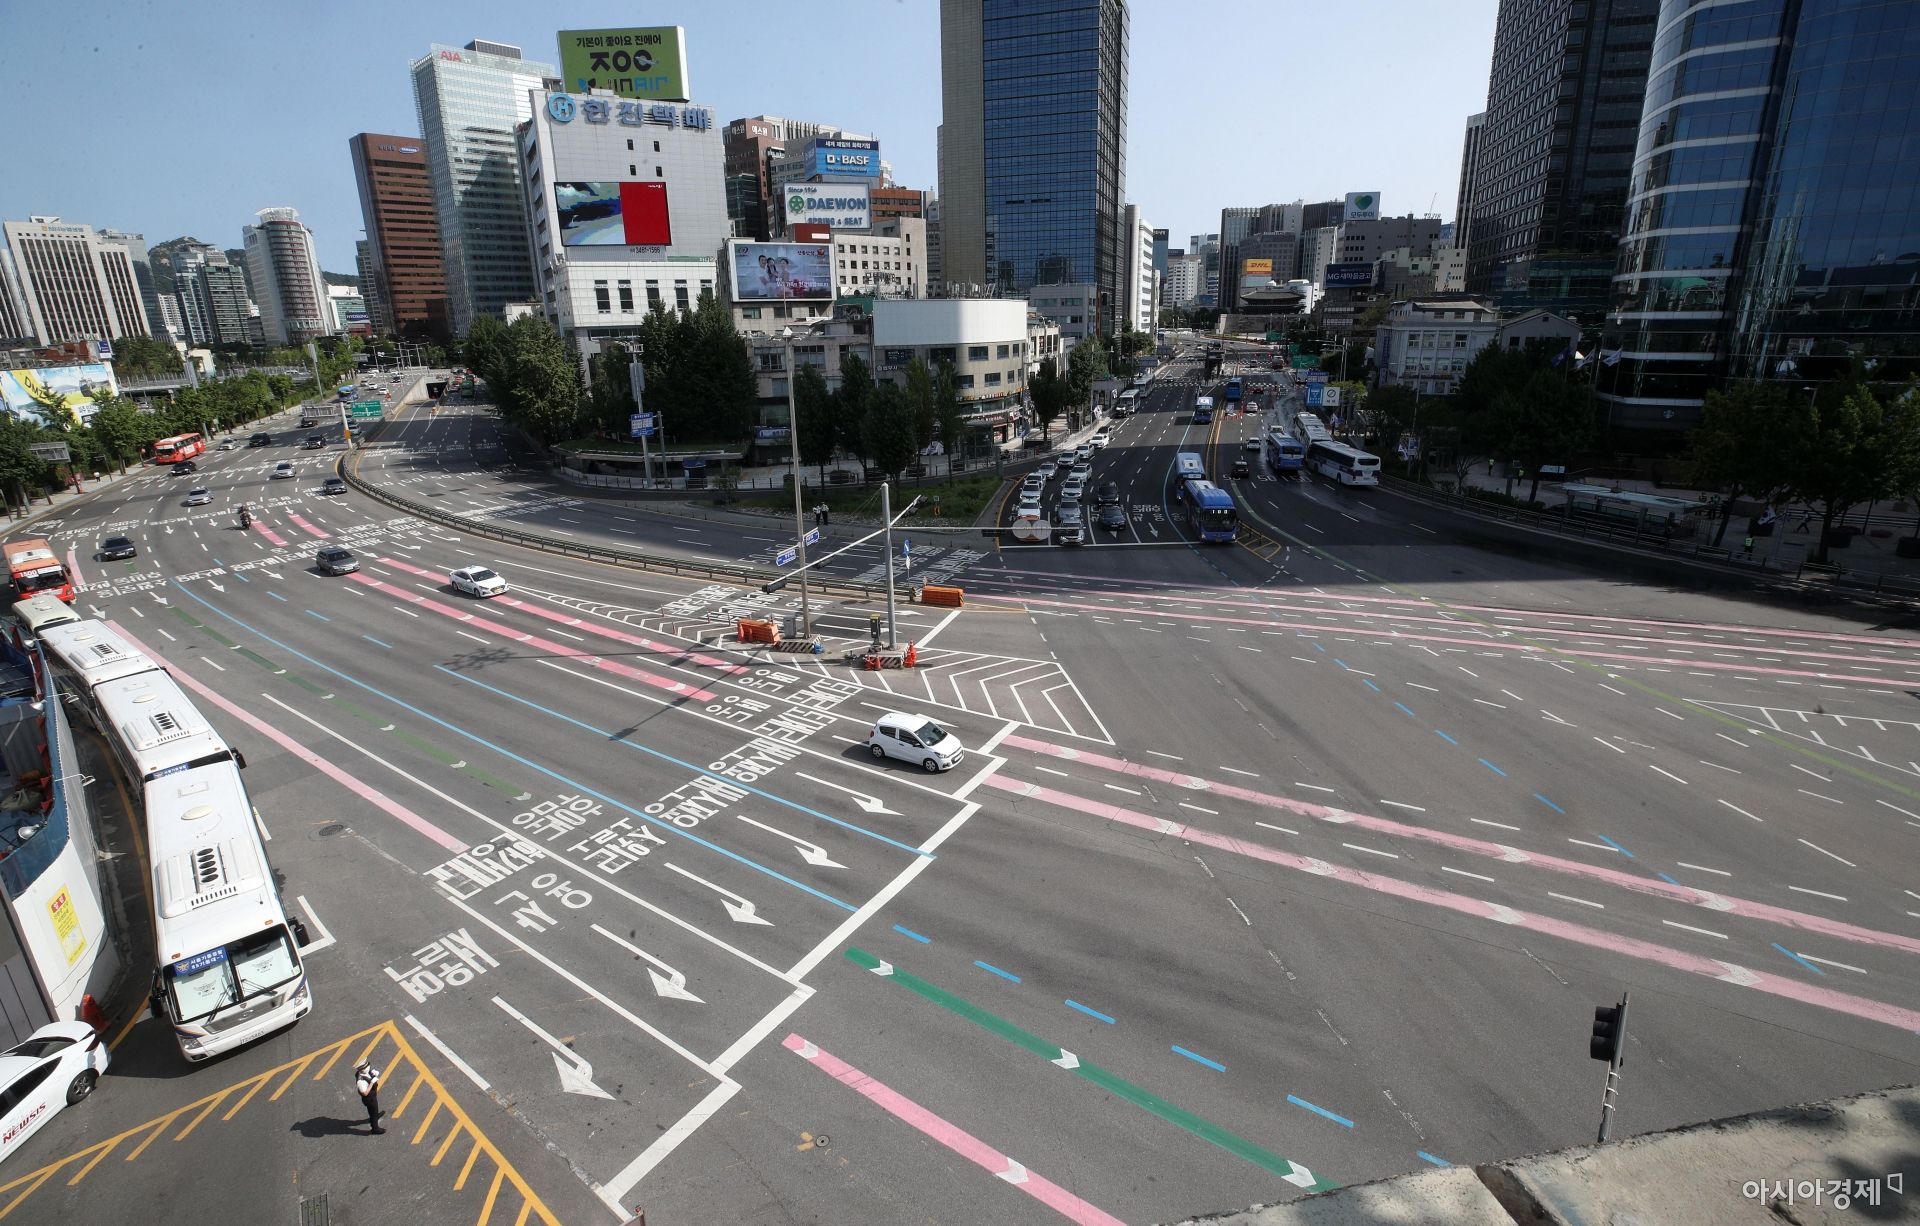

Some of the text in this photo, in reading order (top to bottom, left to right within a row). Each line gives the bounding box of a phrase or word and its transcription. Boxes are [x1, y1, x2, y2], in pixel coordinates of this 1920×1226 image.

[576, 34, 662, 48] 기본이 좋아요 진에어
[583, 99, 709, 130] 한진택배
[751, 125, 768, 137] 에스원
[842, 154, 870, 165] BASF
[806, 198, 867, 210] DAEWON
[1350, 211, 1375, 219] 모두투어
[807, 217, 835, 226] SPRING
[844, 217, 863, 226] SEAT
[1249, 261, 1270, 269] DHL
[25, 376, 45, 399] DMZ
[705, 695, 772, 723] 명동
[708, 737, 802, 783] 버스전용
[644, 774, 750, 828] 버스전용
[512, 794, 603, 842] 후암동
[566, 817, 667, 875] 소월로
[423, 832, 546, 900] 한강대교
[383, 927, 500, 1004] 서울역
[3, 1103, 47, 1145] NEWSIS
